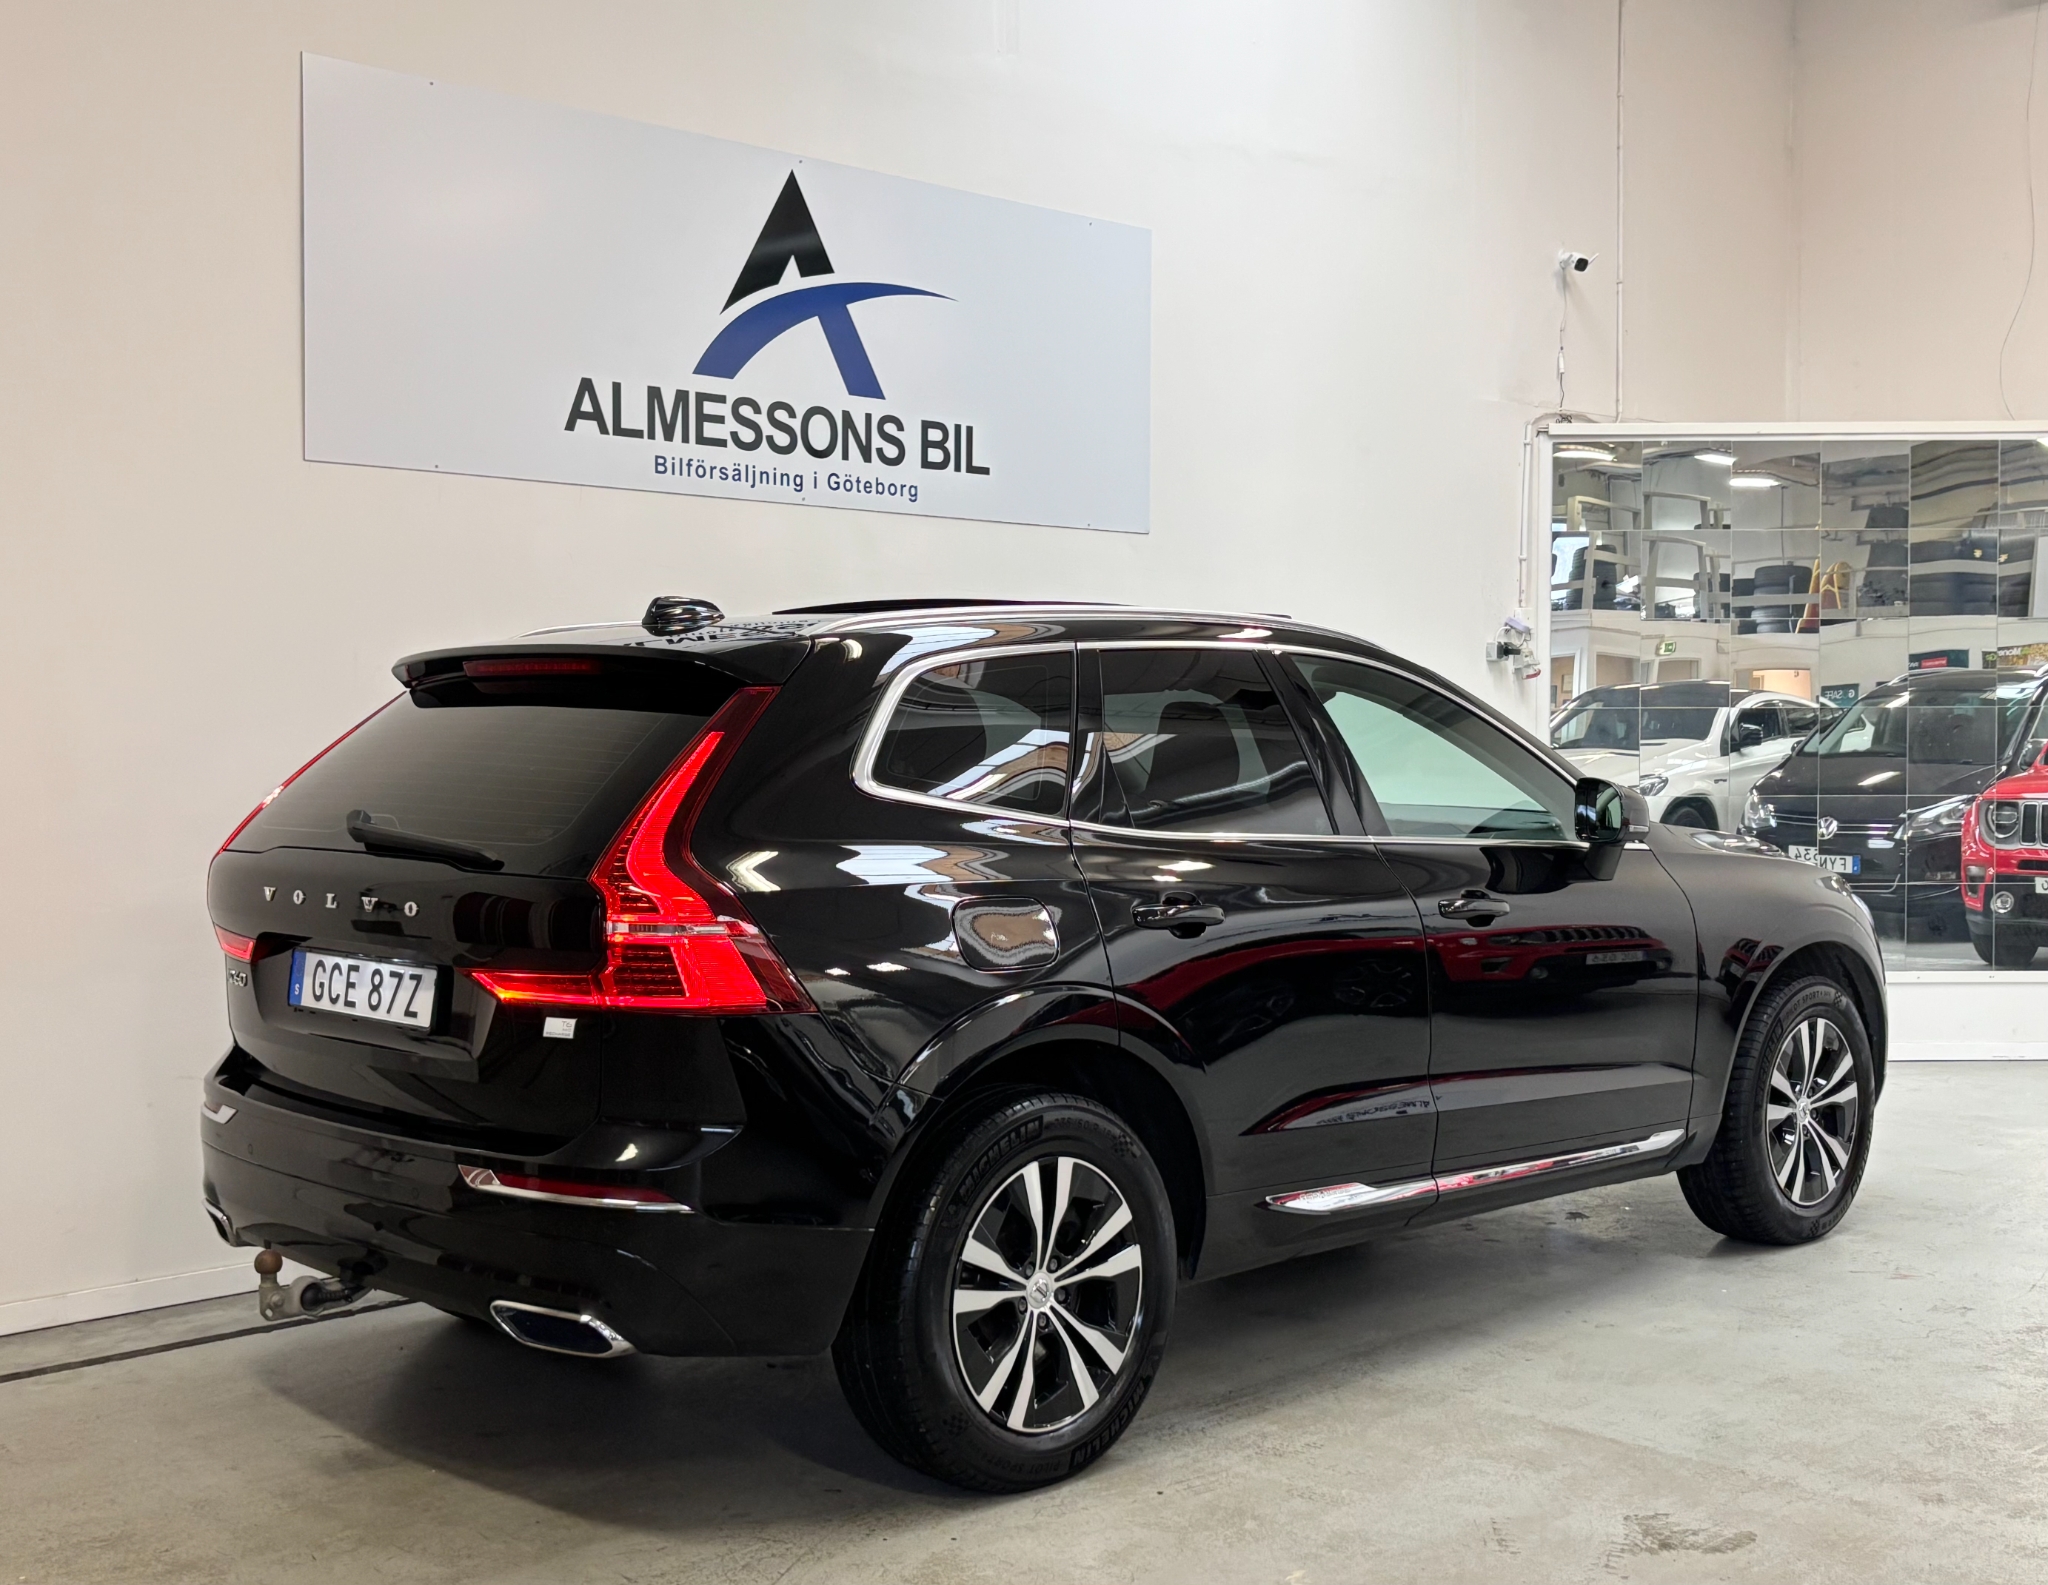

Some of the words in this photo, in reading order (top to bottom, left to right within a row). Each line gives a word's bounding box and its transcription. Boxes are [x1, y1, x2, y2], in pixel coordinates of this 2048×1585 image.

[563, 376, 907, 468] ALMESSONS
[919, 418, 992, 477] BIL
[653, 453, 805, 493] Bilförsäljning
[812, 470, 820, 490] i
[826, 469, 920, 503] Göteborg
[263, 886, 420, 917] VOLVO
[293, 983, 300, 995] S
[312, 958, 361, 1009] GCE
[367, 967, 424, 1019] 87Z
[957, 1117, 1043, 1204] MICHELIN
[1071, 1375, 1145, 1467] MICHELIN
